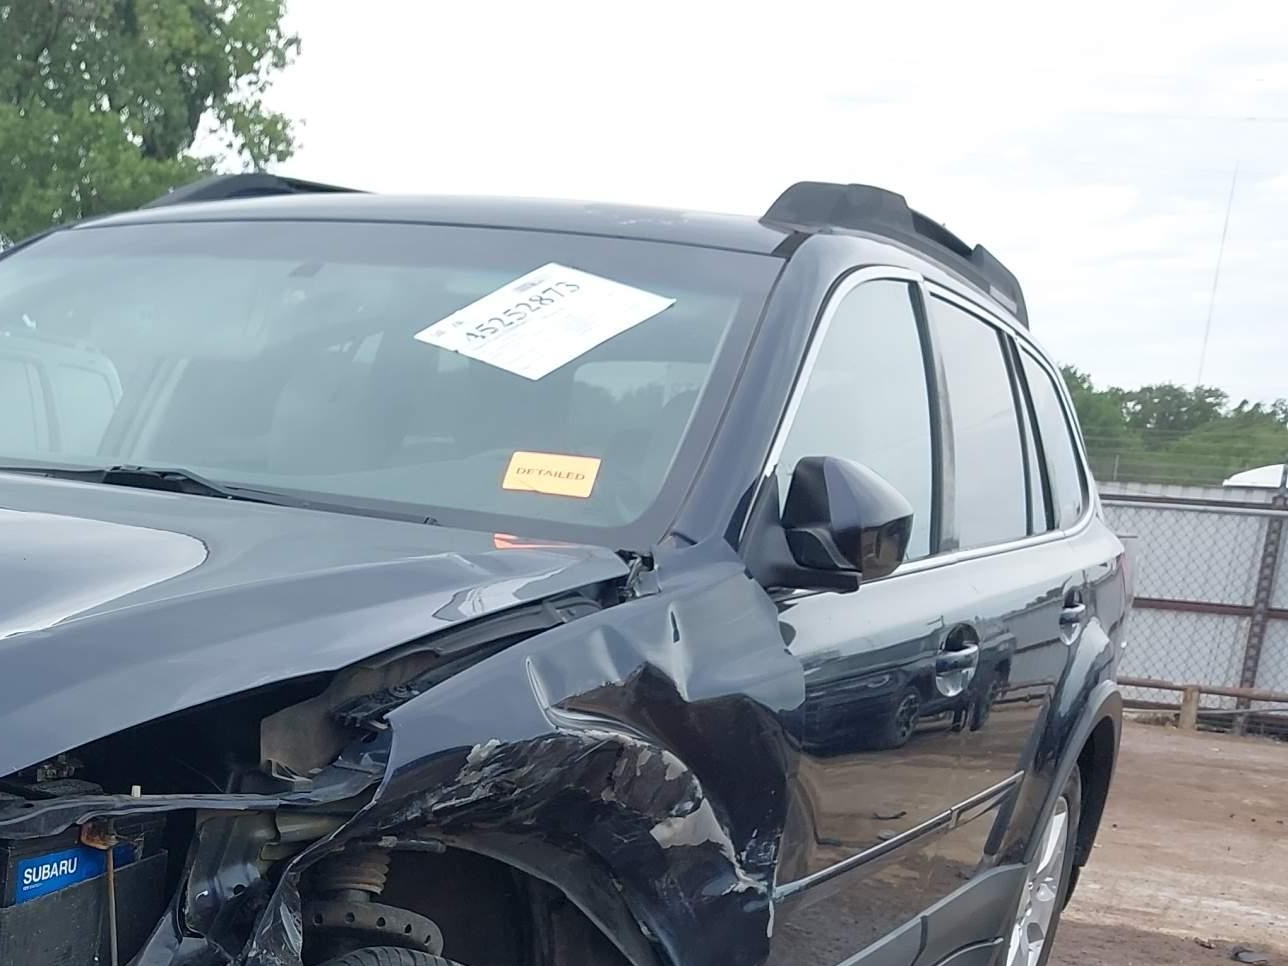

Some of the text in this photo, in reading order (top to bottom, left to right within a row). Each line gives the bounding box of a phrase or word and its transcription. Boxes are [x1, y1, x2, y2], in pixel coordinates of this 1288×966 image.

[466, 281, 580, 341] 45252873
[516, 467, 585, 481] DETAILED
[23, 857, 78, 885] SUBARU
